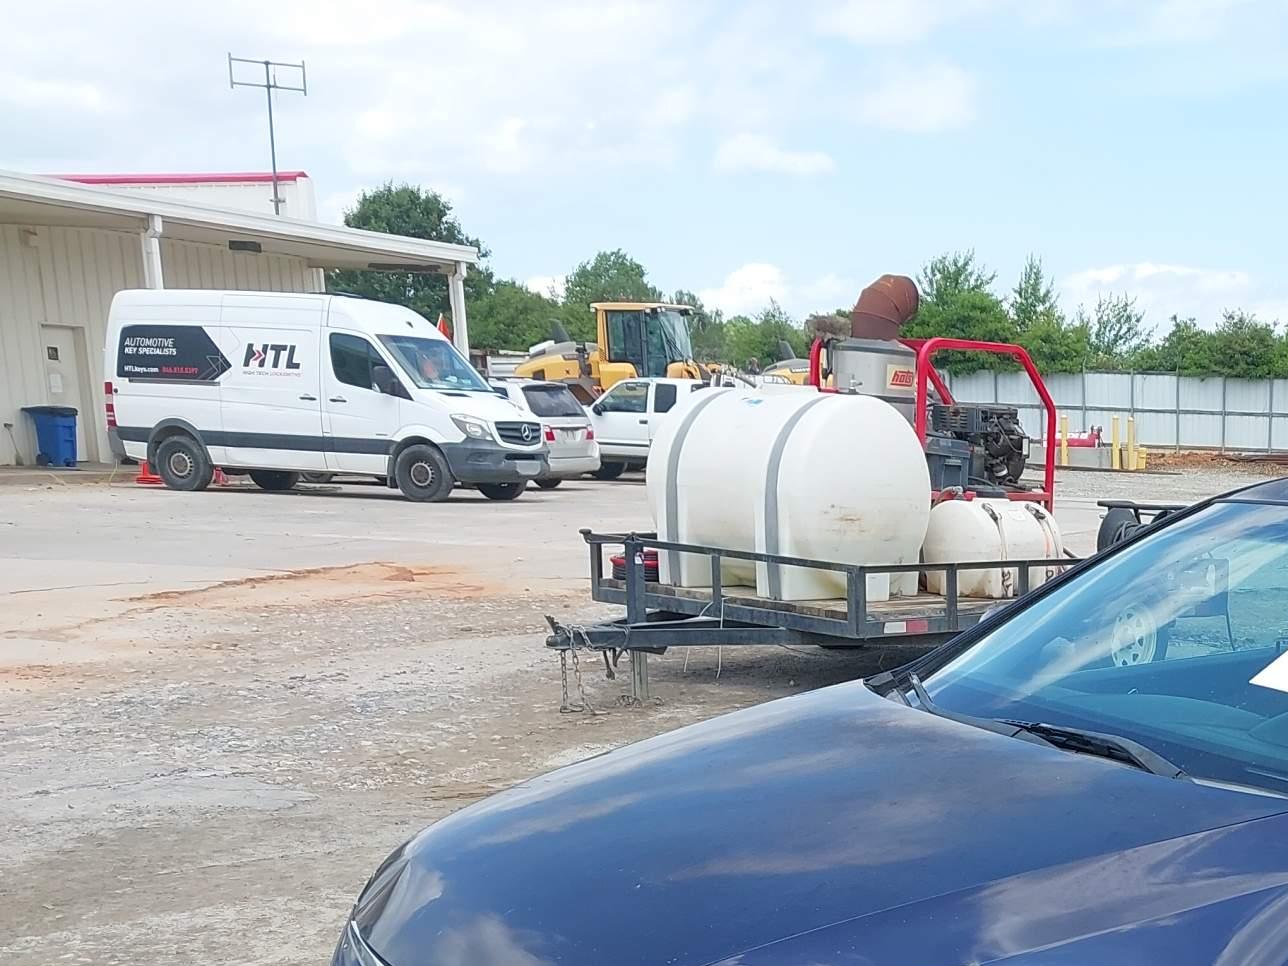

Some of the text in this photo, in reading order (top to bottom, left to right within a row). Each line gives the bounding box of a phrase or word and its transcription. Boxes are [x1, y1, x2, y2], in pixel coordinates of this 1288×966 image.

[124, 337, 176, 348] AUTOMOTIVE
[124, 346, 177, 356] KEY SPECIALISTS
[243, 343, 301, 370] HTL
